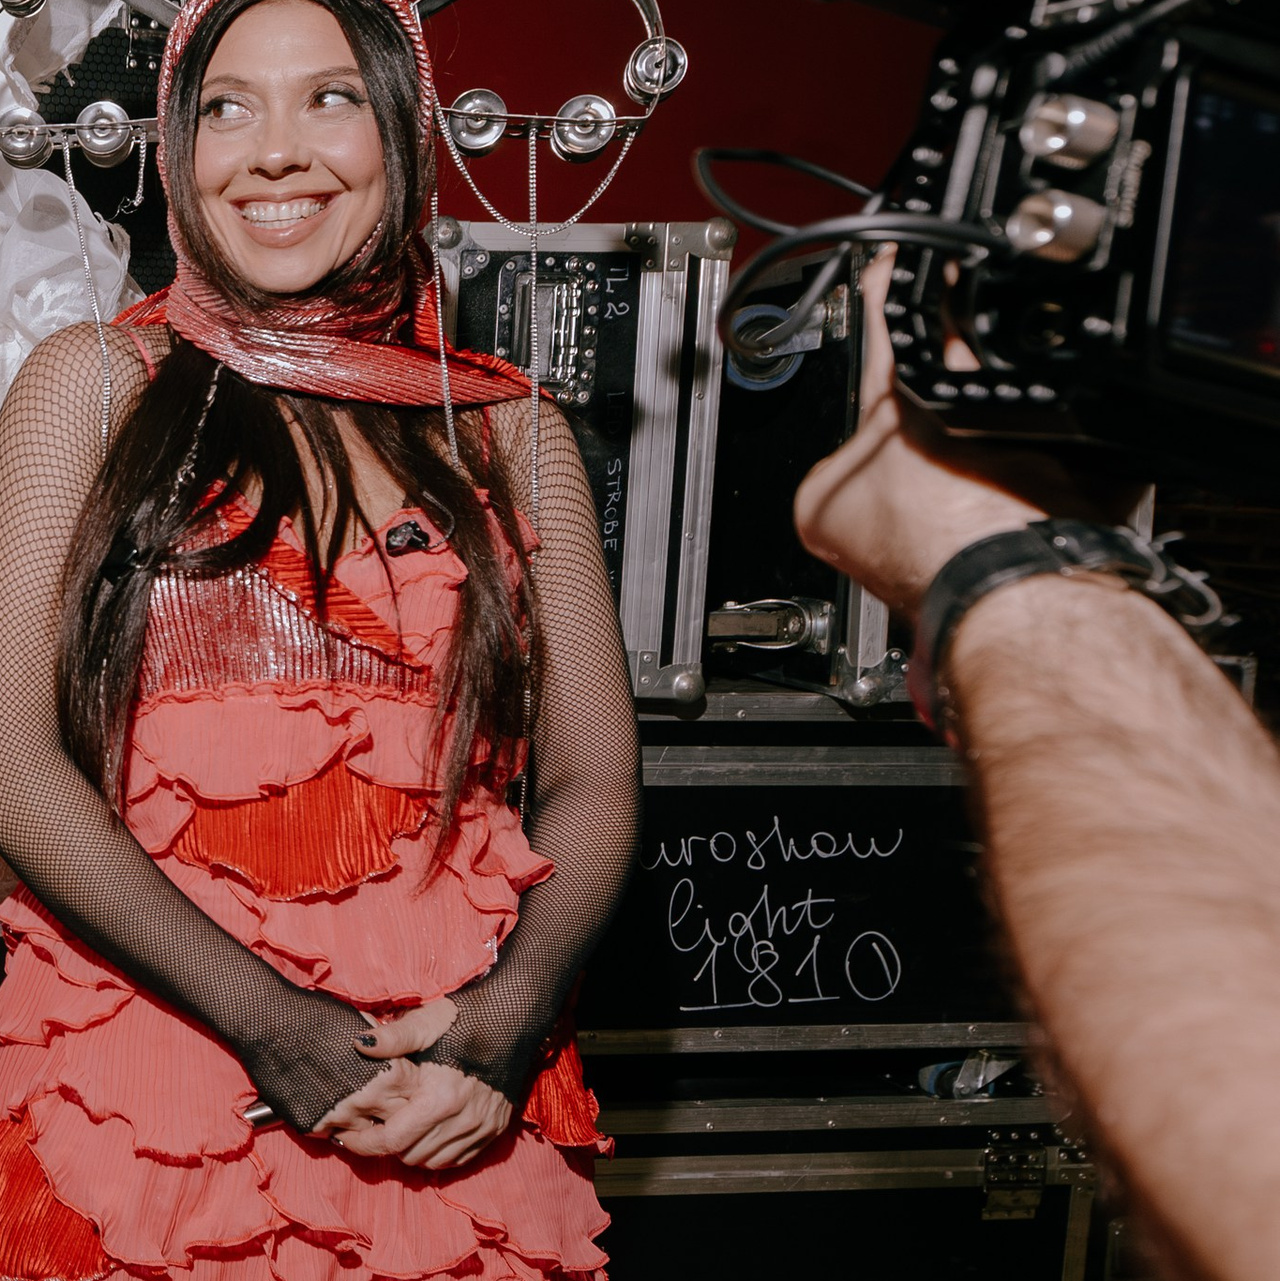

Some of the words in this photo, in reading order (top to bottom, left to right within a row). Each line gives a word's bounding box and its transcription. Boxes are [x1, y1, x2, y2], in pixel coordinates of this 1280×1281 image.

[605, 262, 629, 294] TL
[604, 301, 630, 320] 2
[603, 457, 623, 552] STROBE
[668, 877, 836, 973] light
